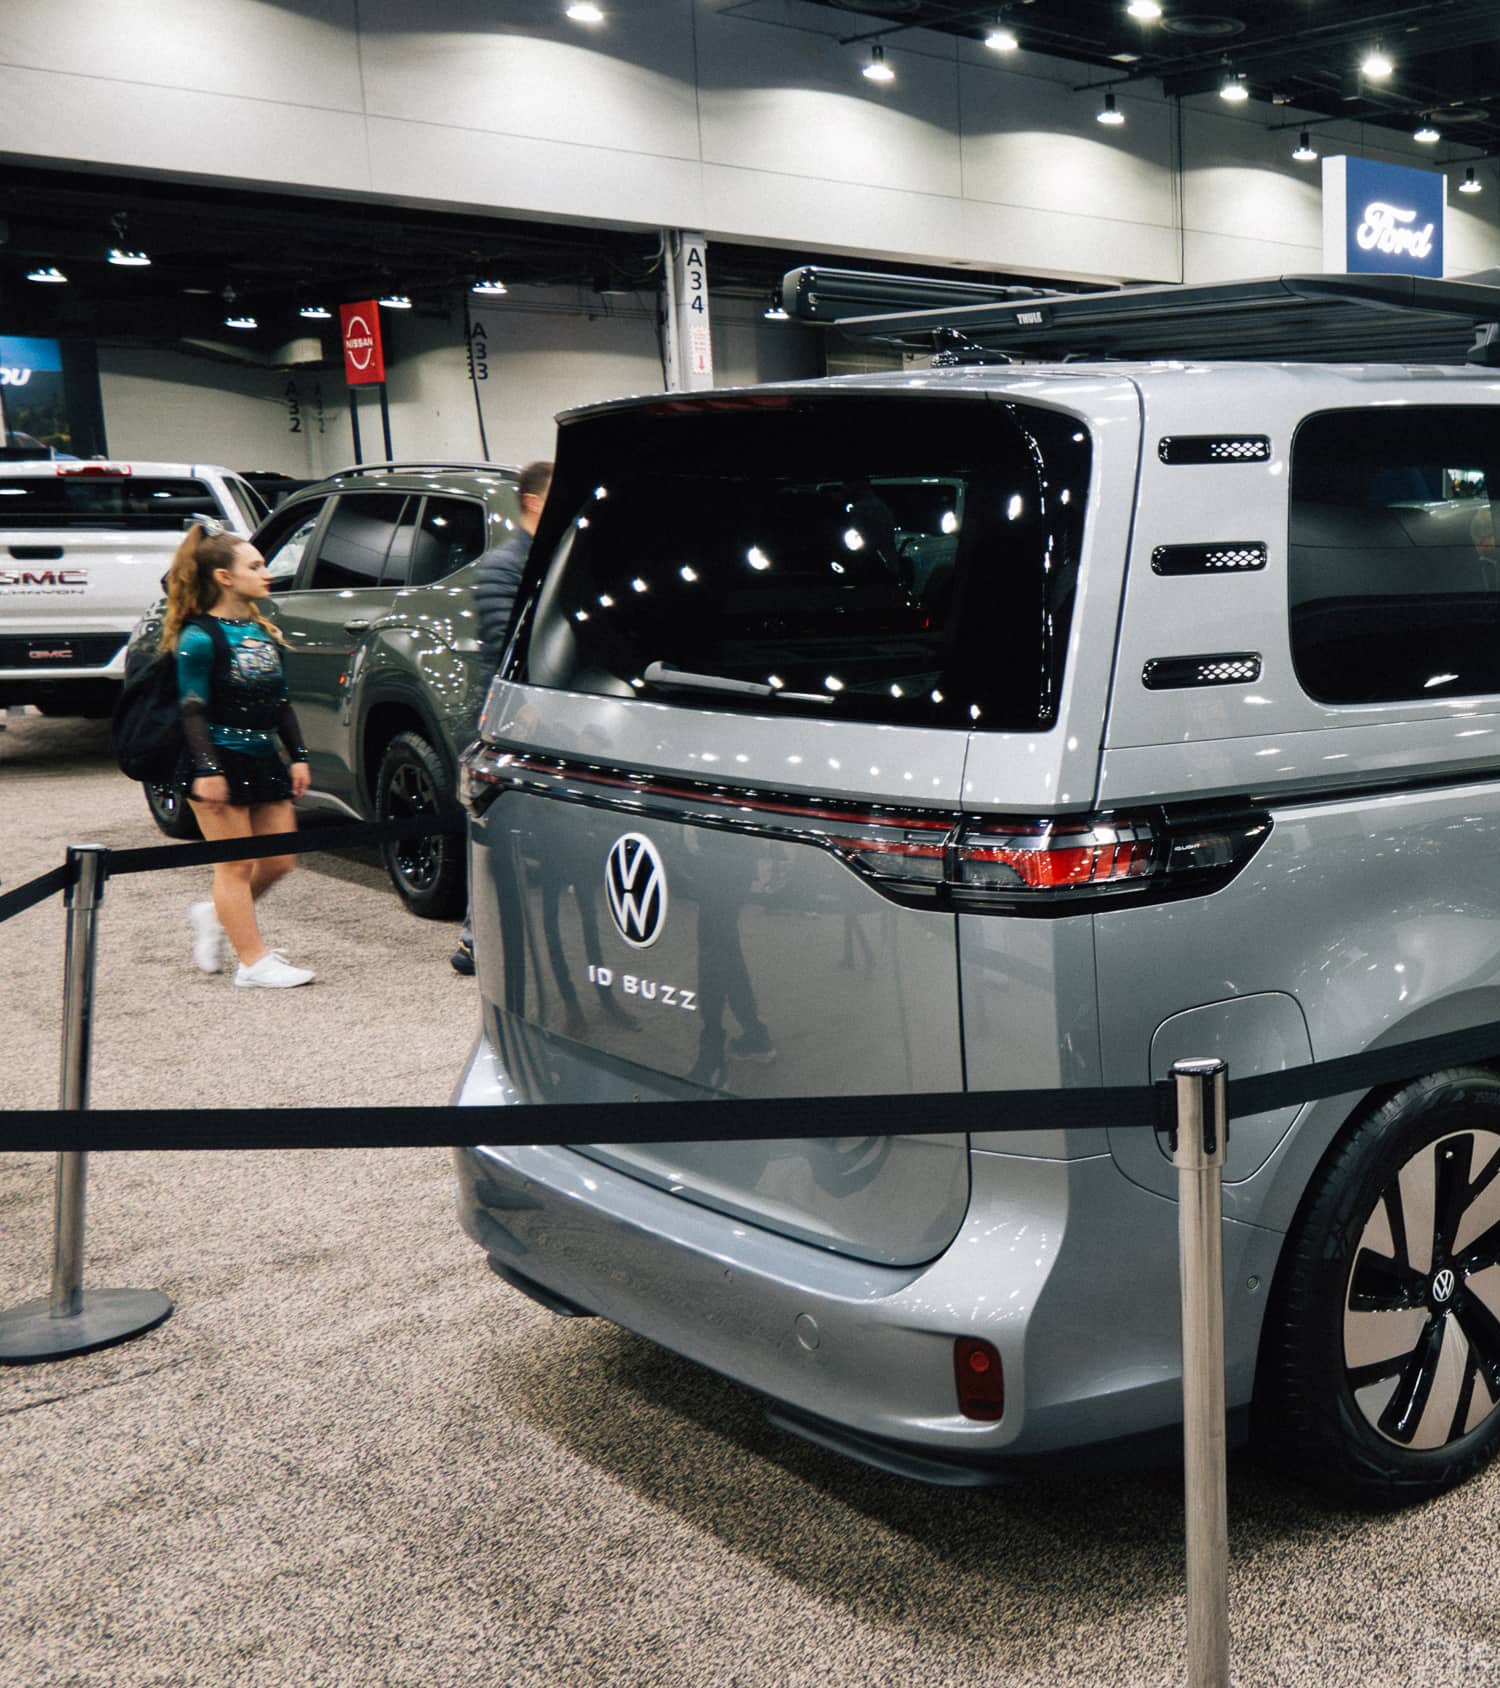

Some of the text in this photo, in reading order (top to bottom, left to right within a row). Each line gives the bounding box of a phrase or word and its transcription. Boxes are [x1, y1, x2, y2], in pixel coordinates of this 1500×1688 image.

[1357, 202, 1434, 258] Ford
[687, 248, 704, 314] A34
[345, 337, 373, 349] NISSAN
[588, 965, 697, 1011] ID BUZZ
